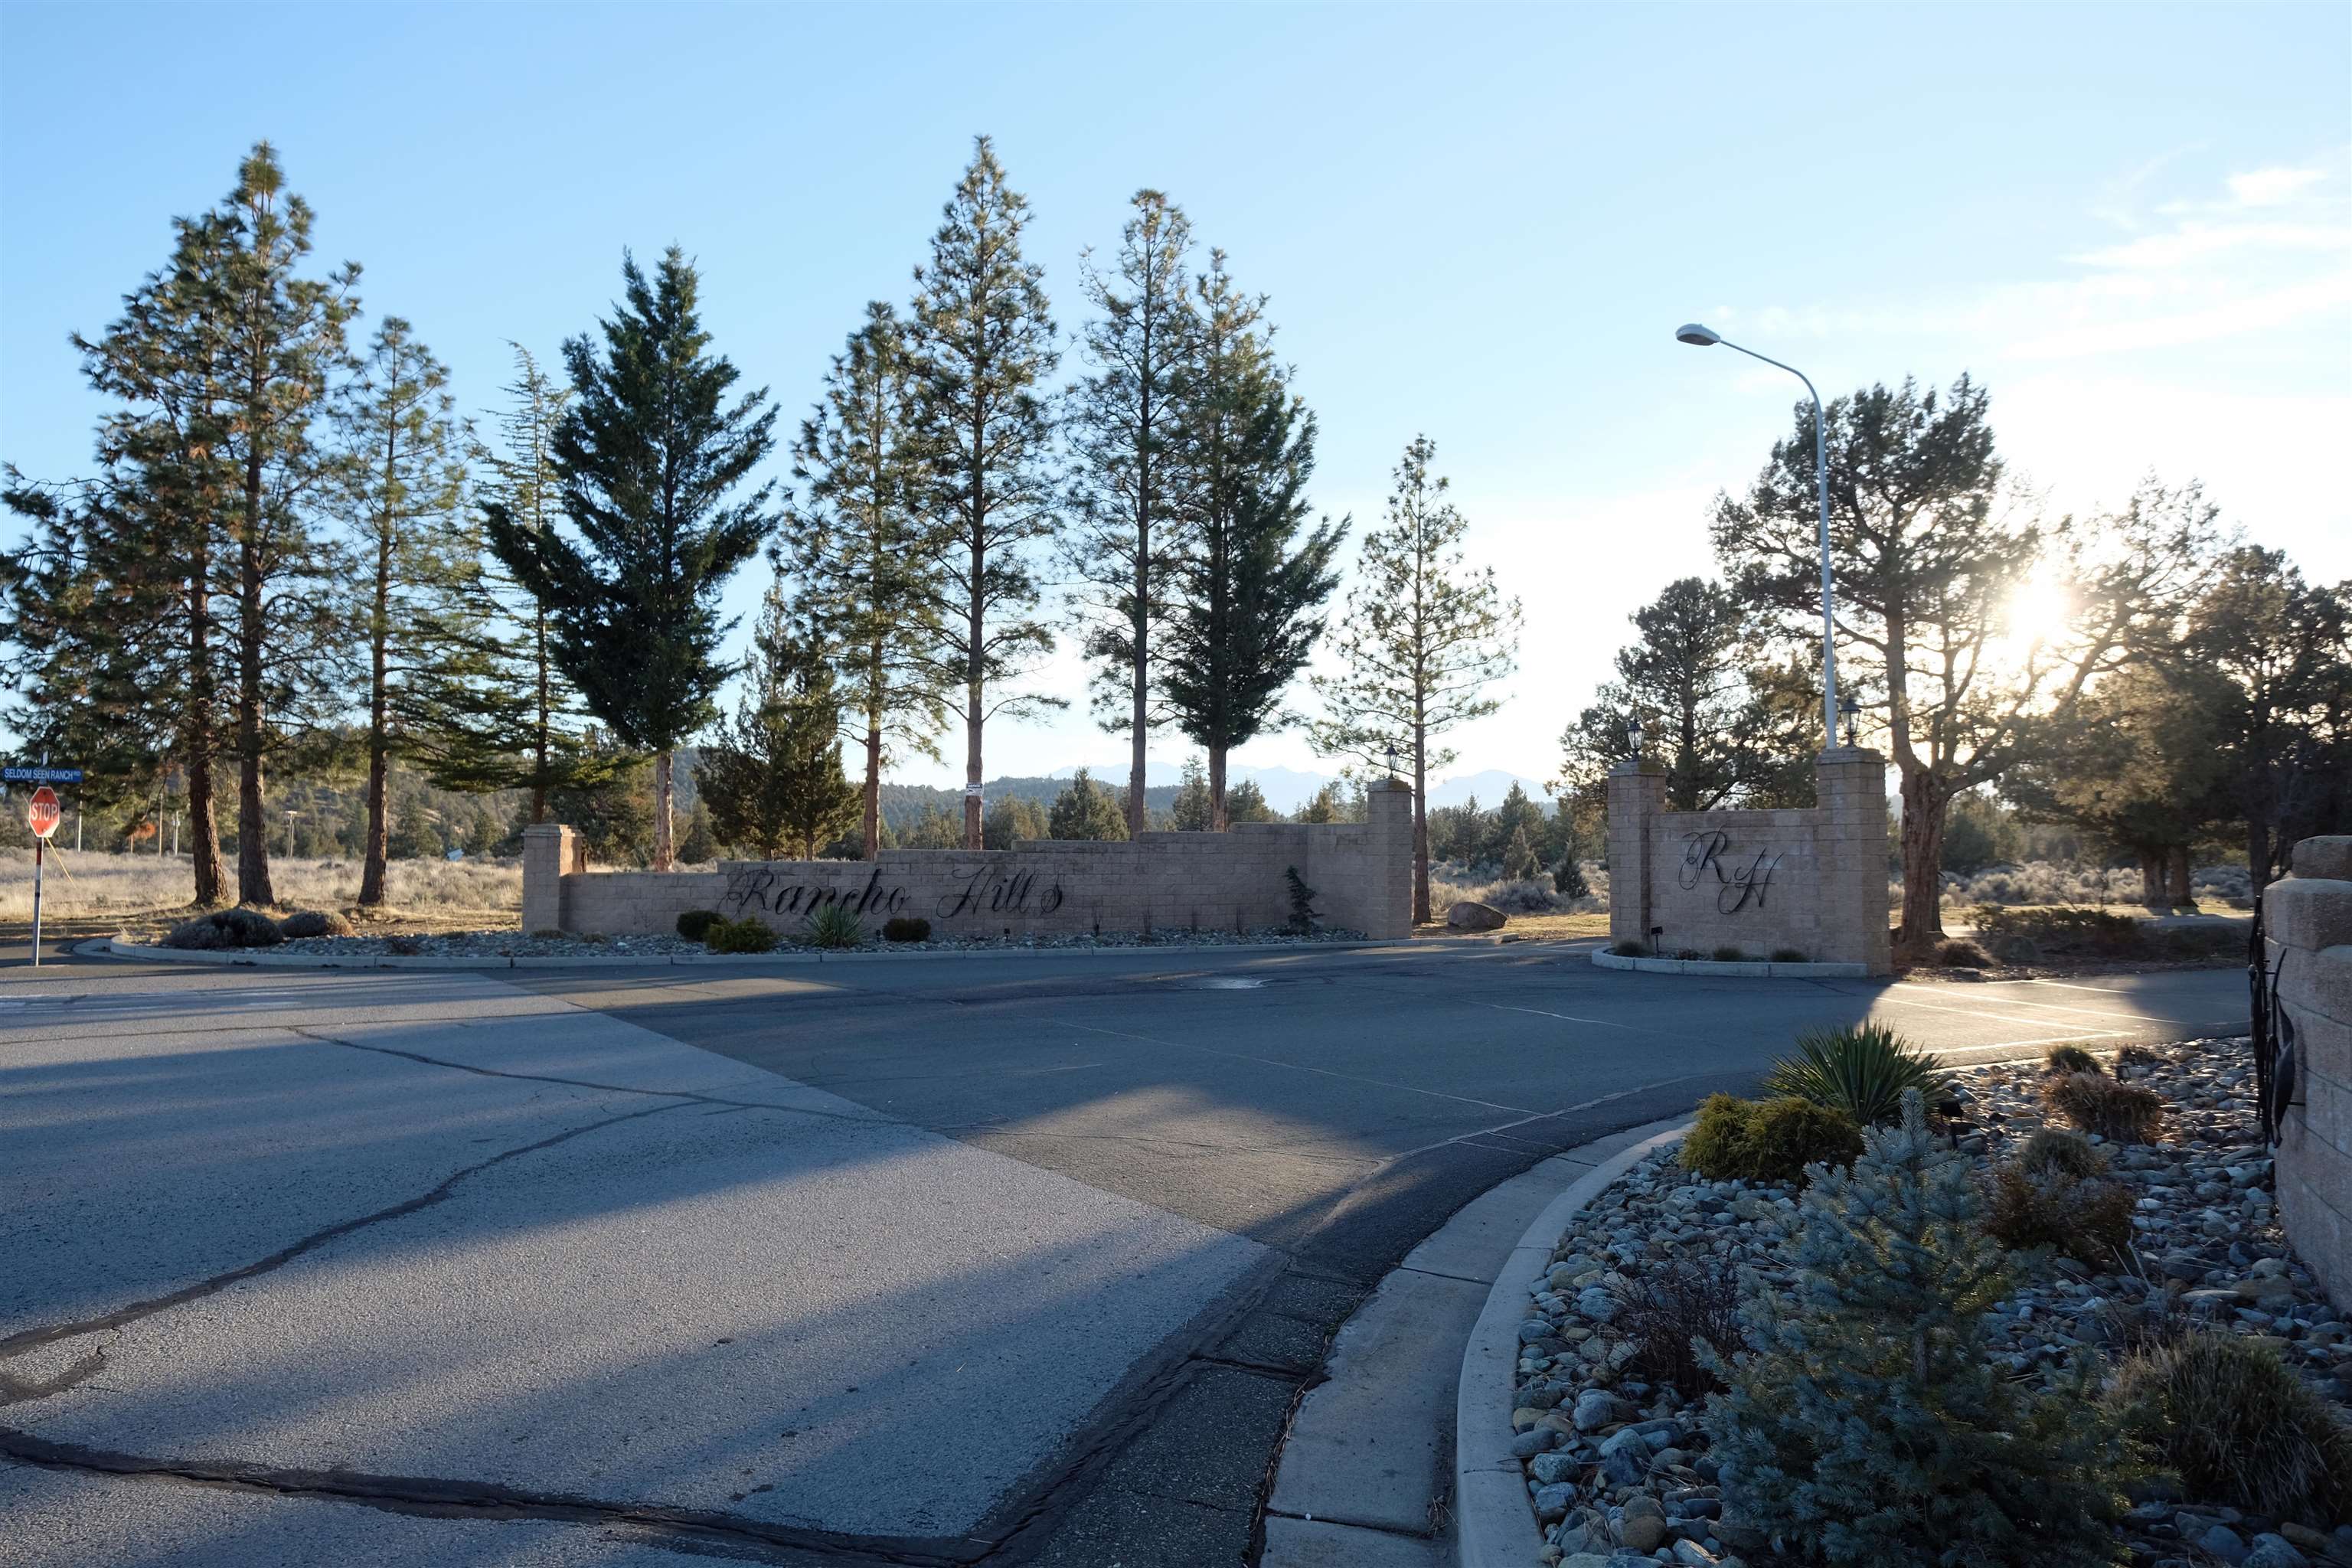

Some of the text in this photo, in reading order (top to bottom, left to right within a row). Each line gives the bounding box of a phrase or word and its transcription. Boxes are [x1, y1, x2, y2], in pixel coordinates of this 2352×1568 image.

[4, 768, 32, 779] SELDOM
[32, 769, 50, 779] SEEN
[51, 769, 74, 780] RANCH
[31, 802, 58, 821] STOP
[717, 864, 1063, 919] Rancho Hills
